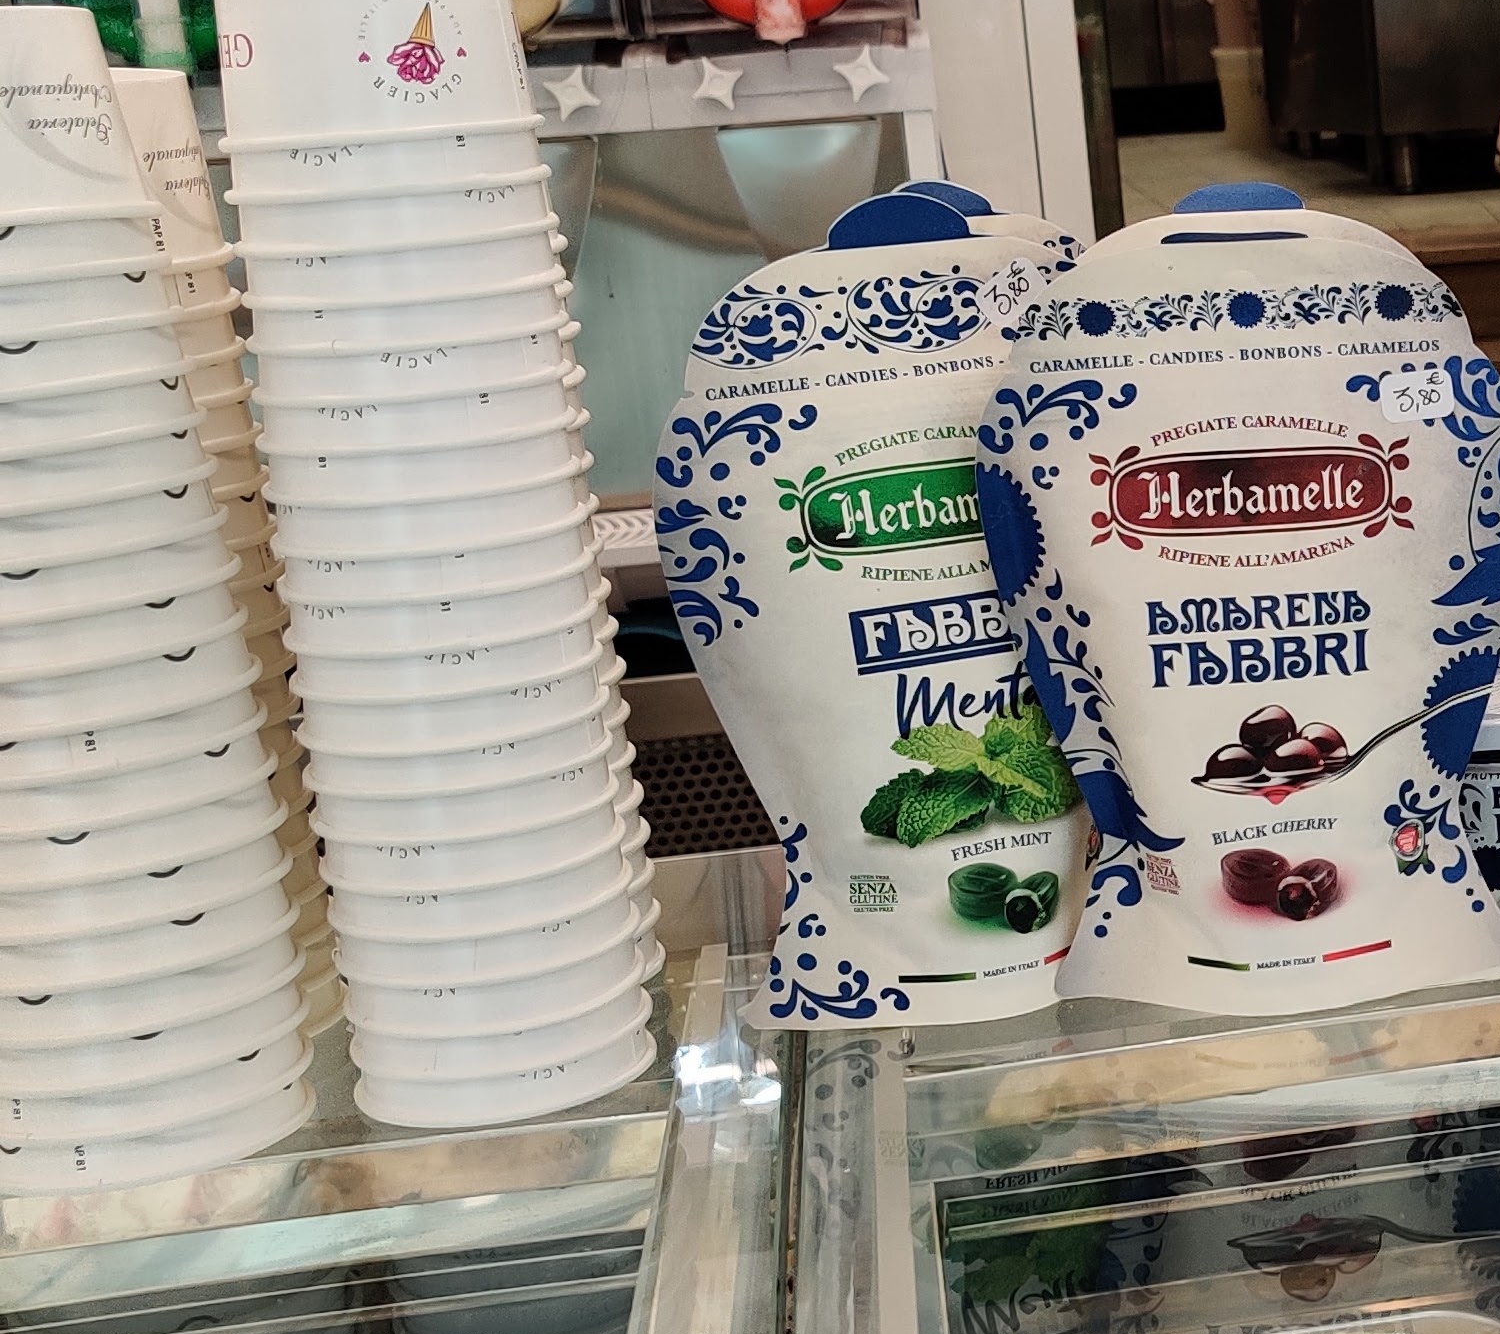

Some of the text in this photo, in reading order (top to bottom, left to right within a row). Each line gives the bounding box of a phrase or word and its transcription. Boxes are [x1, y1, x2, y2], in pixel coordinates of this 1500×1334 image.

[372, 73, 463, 104] GLACIER
[1029, 339, 1441, 374] CARAMELLE CANDIES BONBONS CARAMELOS
[705, 355, 994, 402] CARAMELLE CANDIES BONBONS
[835, 429, 921, 467] PREGIATE
[1150, 415, 1350, 449] PREGIATE CARAMELLE
[1138, 463, 1367, 522] Herbamelle
[1158, 535, 1356, 569] RIPIENE ALL'AMARENA
[861, 565, 935, 582] RIPIENE
[1146, 590, 1372, 636] AMARENA
[1150, 628, 1372, 689] FABBRI
[951, 830, 1053, 862] FRESH MINT
[1211, 816, 1339, 846] BLACK CHERRY
[849, 882, 898, 895] SENZA
[849, 894, 899, 904] GLUTINE
